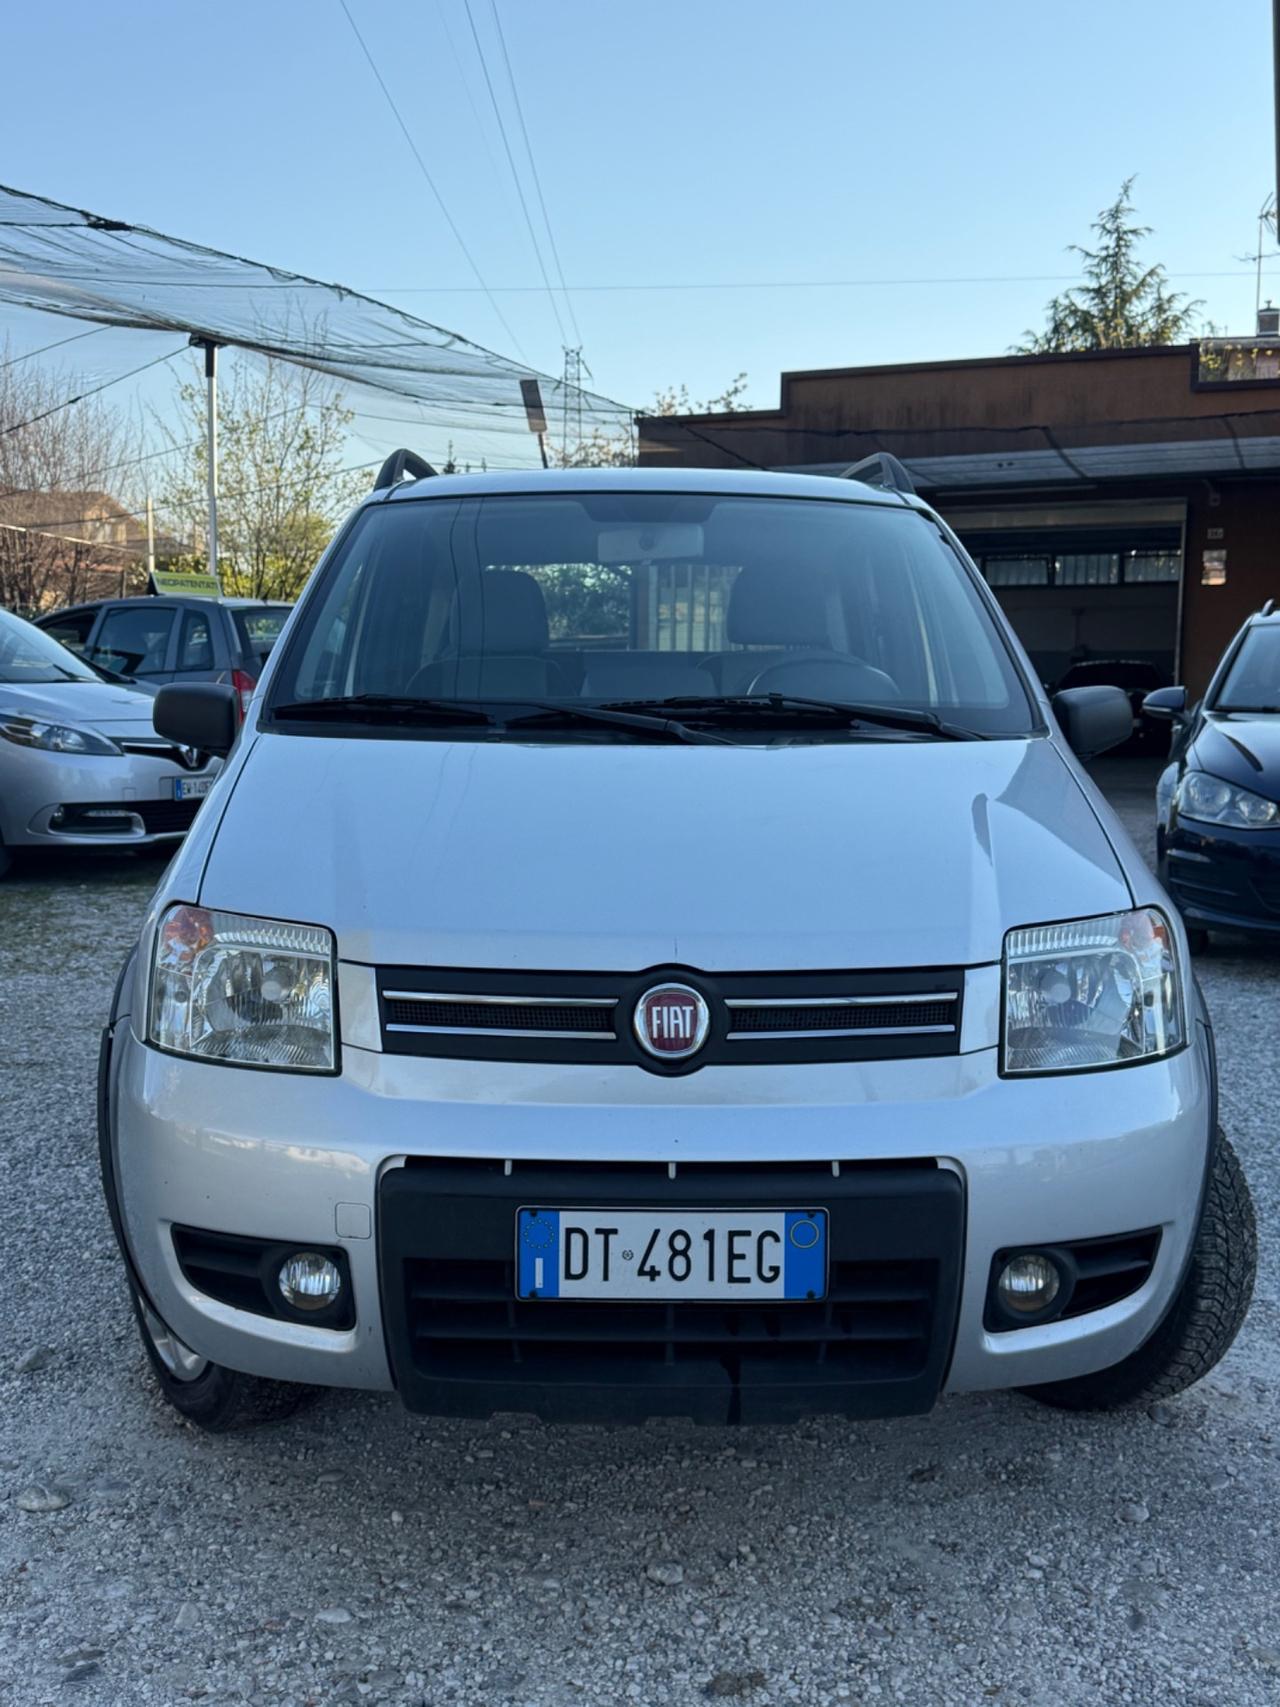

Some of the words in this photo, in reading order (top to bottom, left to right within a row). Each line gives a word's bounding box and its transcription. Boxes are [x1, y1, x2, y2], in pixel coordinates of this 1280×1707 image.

[652, 1006, 694, 1038] FIAT
[564, 1227, 618, 1281] DT
[637, 1229, 781, 1283] 481EG
[535, 1257, 543, 1288] I
